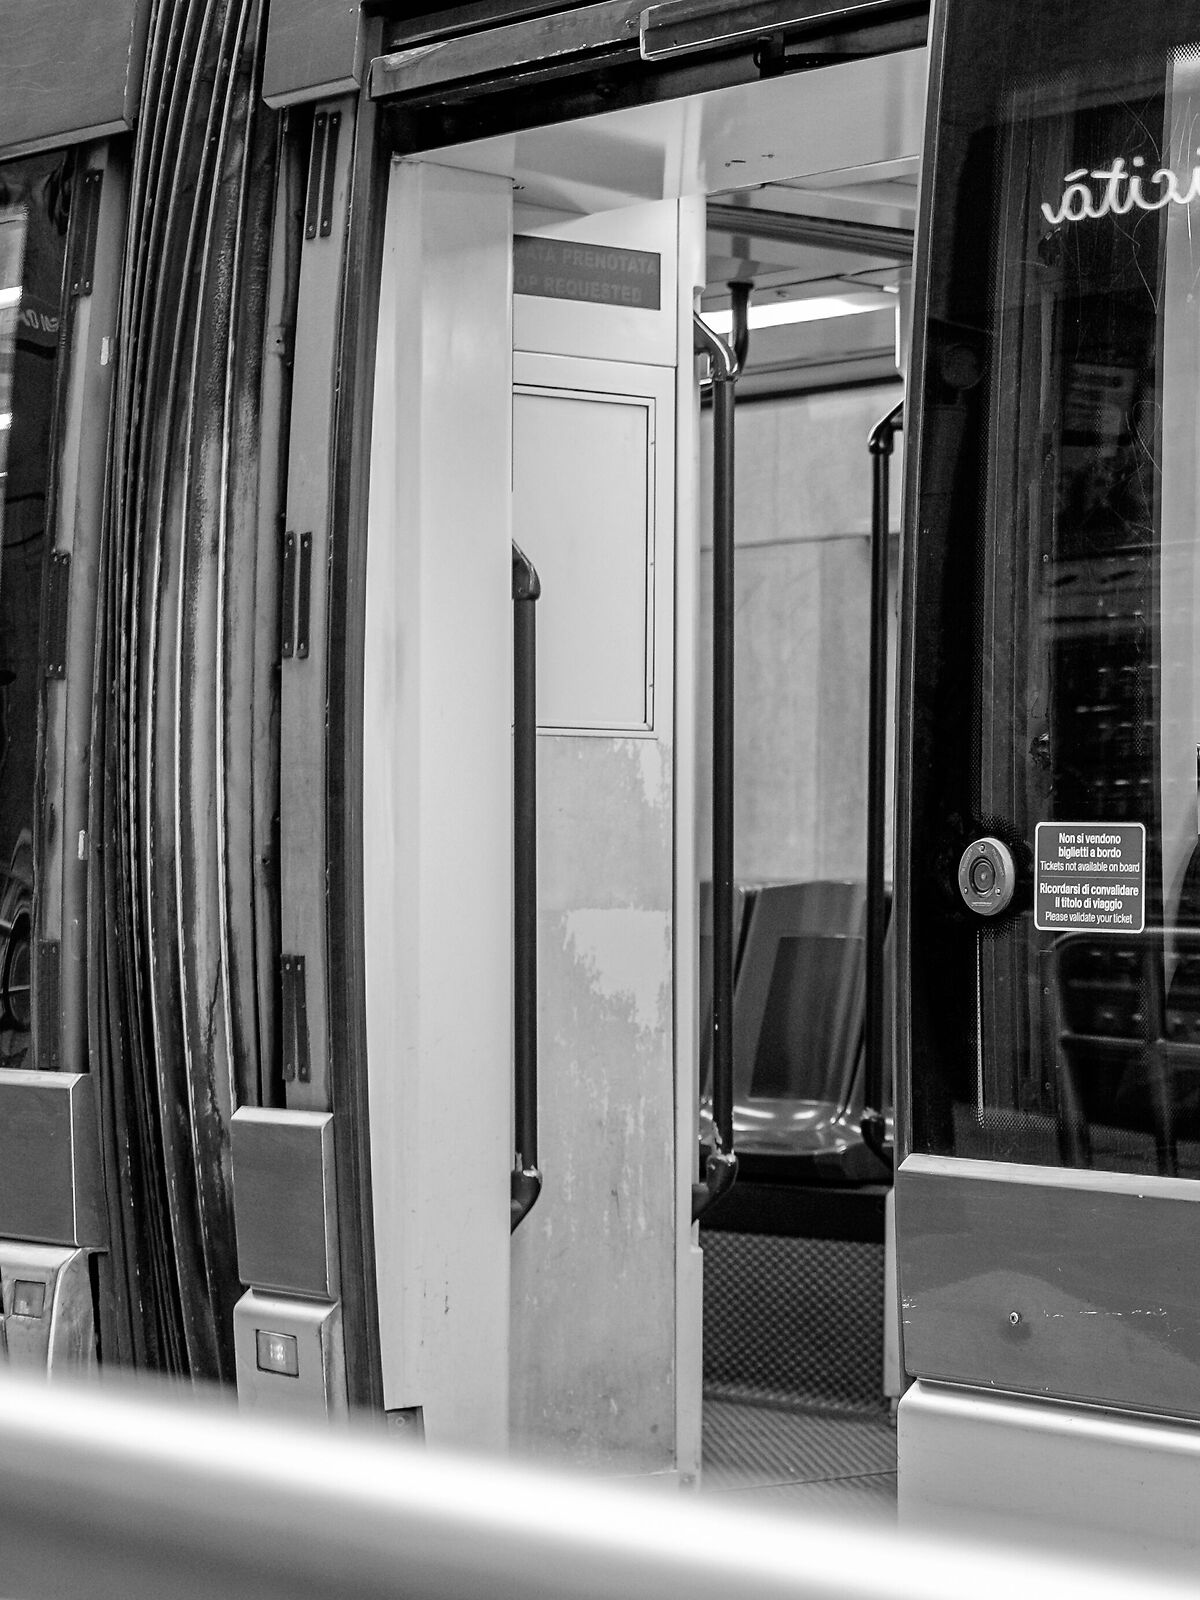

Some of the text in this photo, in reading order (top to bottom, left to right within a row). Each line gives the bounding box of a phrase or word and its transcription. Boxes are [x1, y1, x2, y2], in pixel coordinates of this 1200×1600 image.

[562, 248, 657, 275] PRENOTATA
[543, 276, 642, 303] REQUESTED
[1059, 833, 1121, 845] Non si vendono
[1058, 847, 1121, 859] biglietti a bordo
[1040, 861, 1140, 872] Tickets not available on board
[1040, 883, 1139, 896] Ricordarsi di convalidare
[1061, 897, 1082, 909] titolo
[1083, 898, 1091, 909] di
[1092, 898, 1123, 912] viaggio
[1045, 911, 1133, 924] Please validate your ticket
